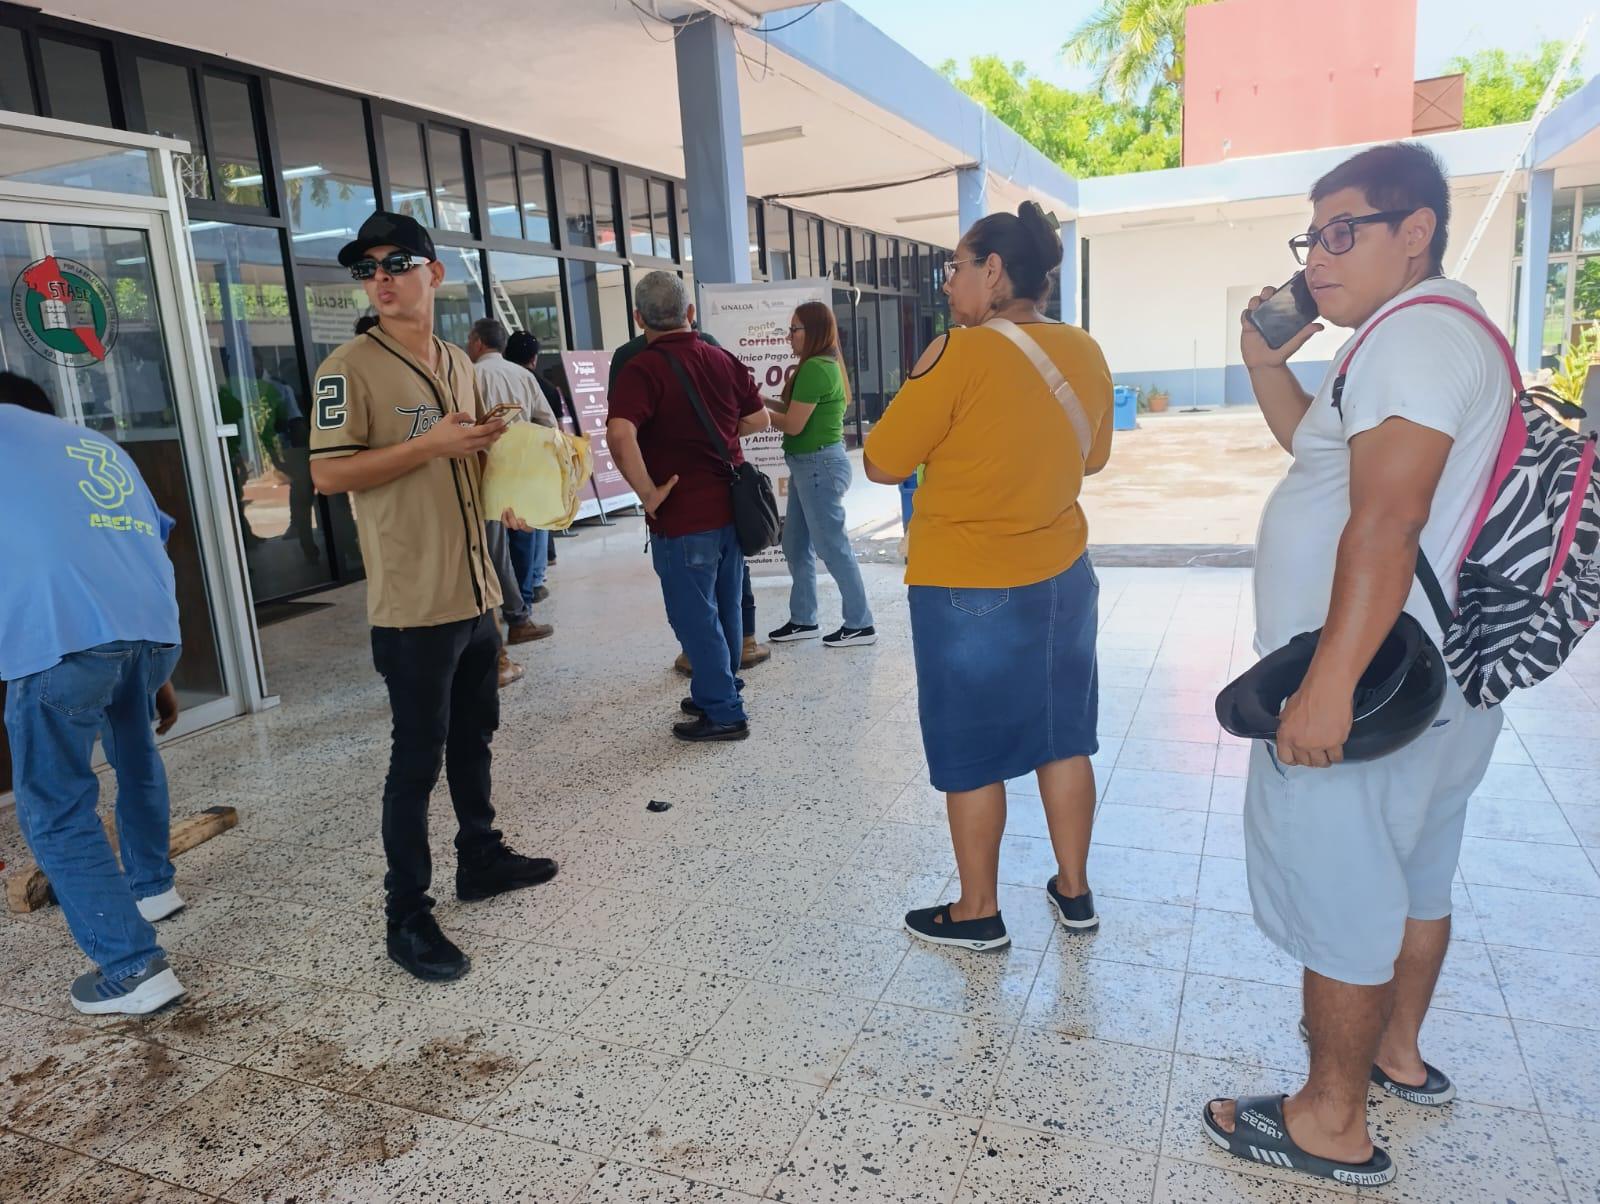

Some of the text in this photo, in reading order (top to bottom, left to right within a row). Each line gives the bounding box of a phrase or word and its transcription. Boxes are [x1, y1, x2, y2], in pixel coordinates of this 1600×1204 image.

[720, 303, 753, 311] SINALOA
[765, 353, 789, 362] Pago
[316, 374, 347, 430] 2
[1390, 1084, 1435, 1105] FASHION
[1339, 1171, 1388, 1185] FASHION
